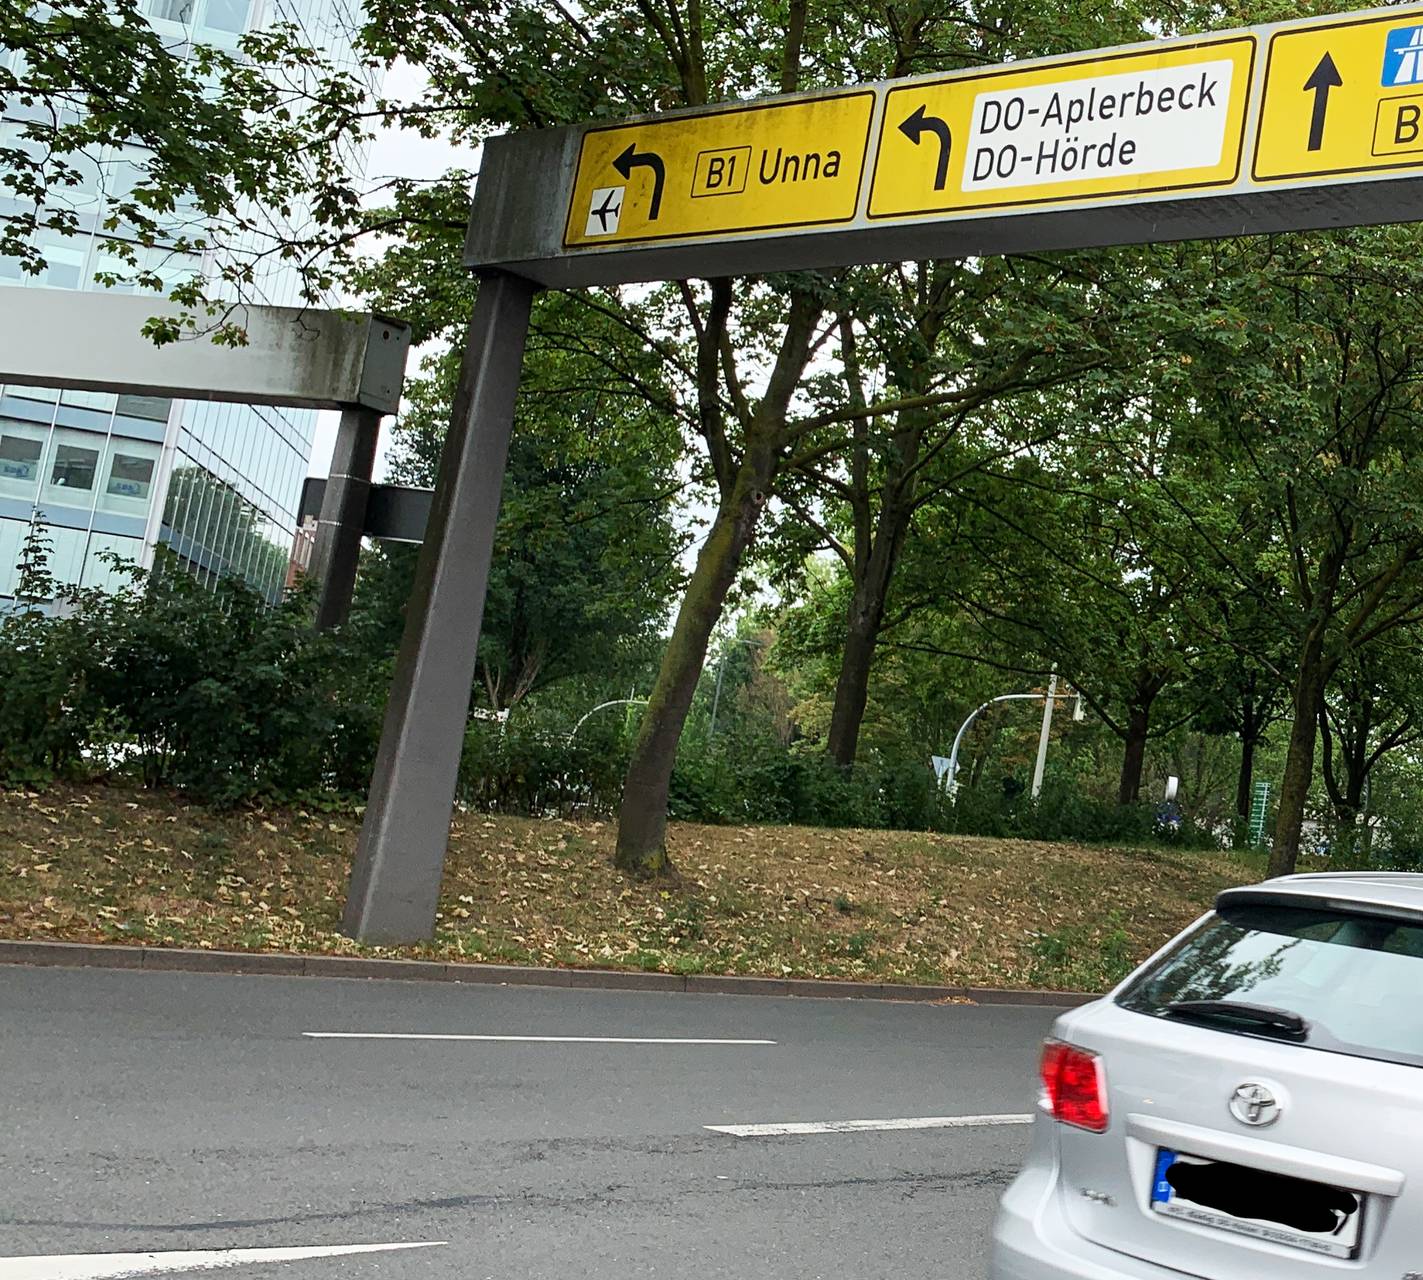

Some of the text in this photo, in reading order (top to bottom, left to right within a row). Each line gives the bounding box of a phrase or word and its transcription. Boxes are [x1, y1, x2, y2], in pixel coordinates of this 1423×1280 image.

[980, 73, 1217, 135] DO-Aplerbeck
[706, 146, 841, 190] B1 Unna
[972, 135, 1137, 182] DO-Hörde
